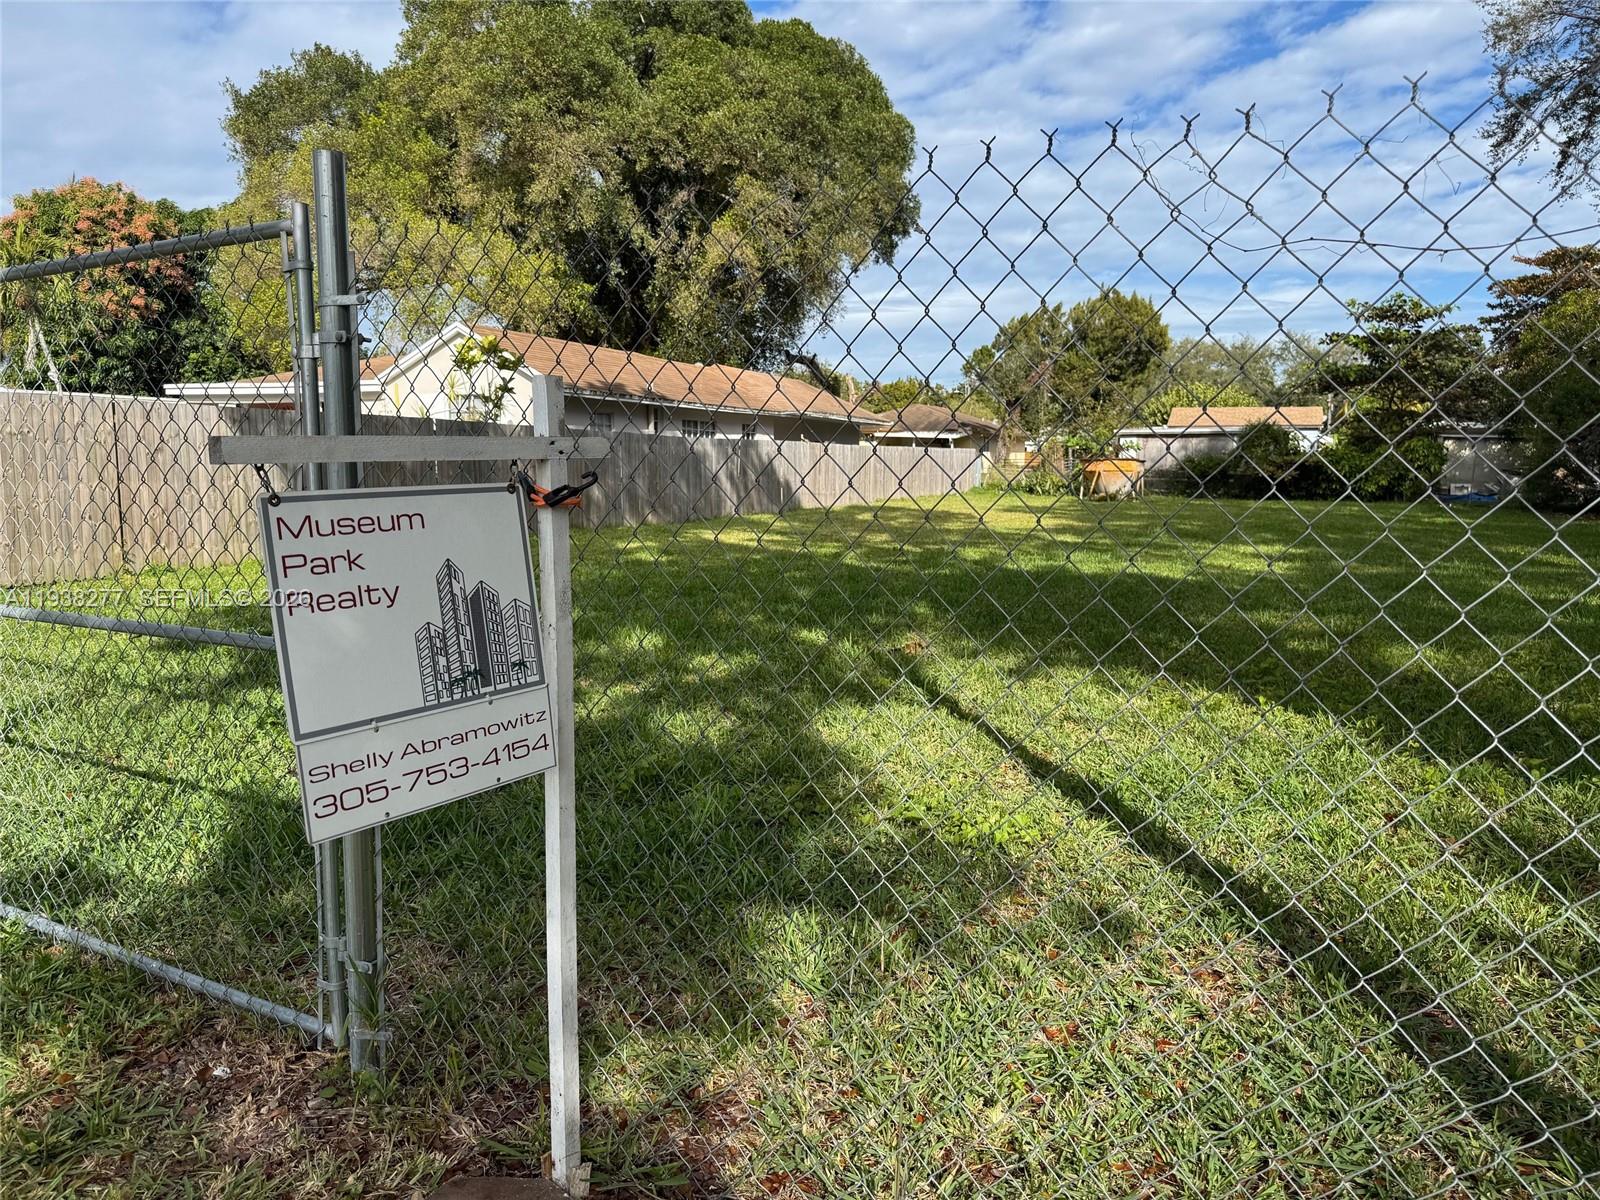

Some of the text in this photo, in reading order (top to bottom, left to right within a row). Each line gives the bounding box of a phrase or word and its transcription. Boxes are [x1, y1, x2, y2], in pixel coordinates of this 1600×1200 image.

[276, 512, 426, 541] Museum
[281, 549, 366, 578] Park
[285, 584, 400, 617] Realty
[308, 709, 548, 784] Shelly Abramowitz
[313, 733, 550, 820] 305-753-4154
